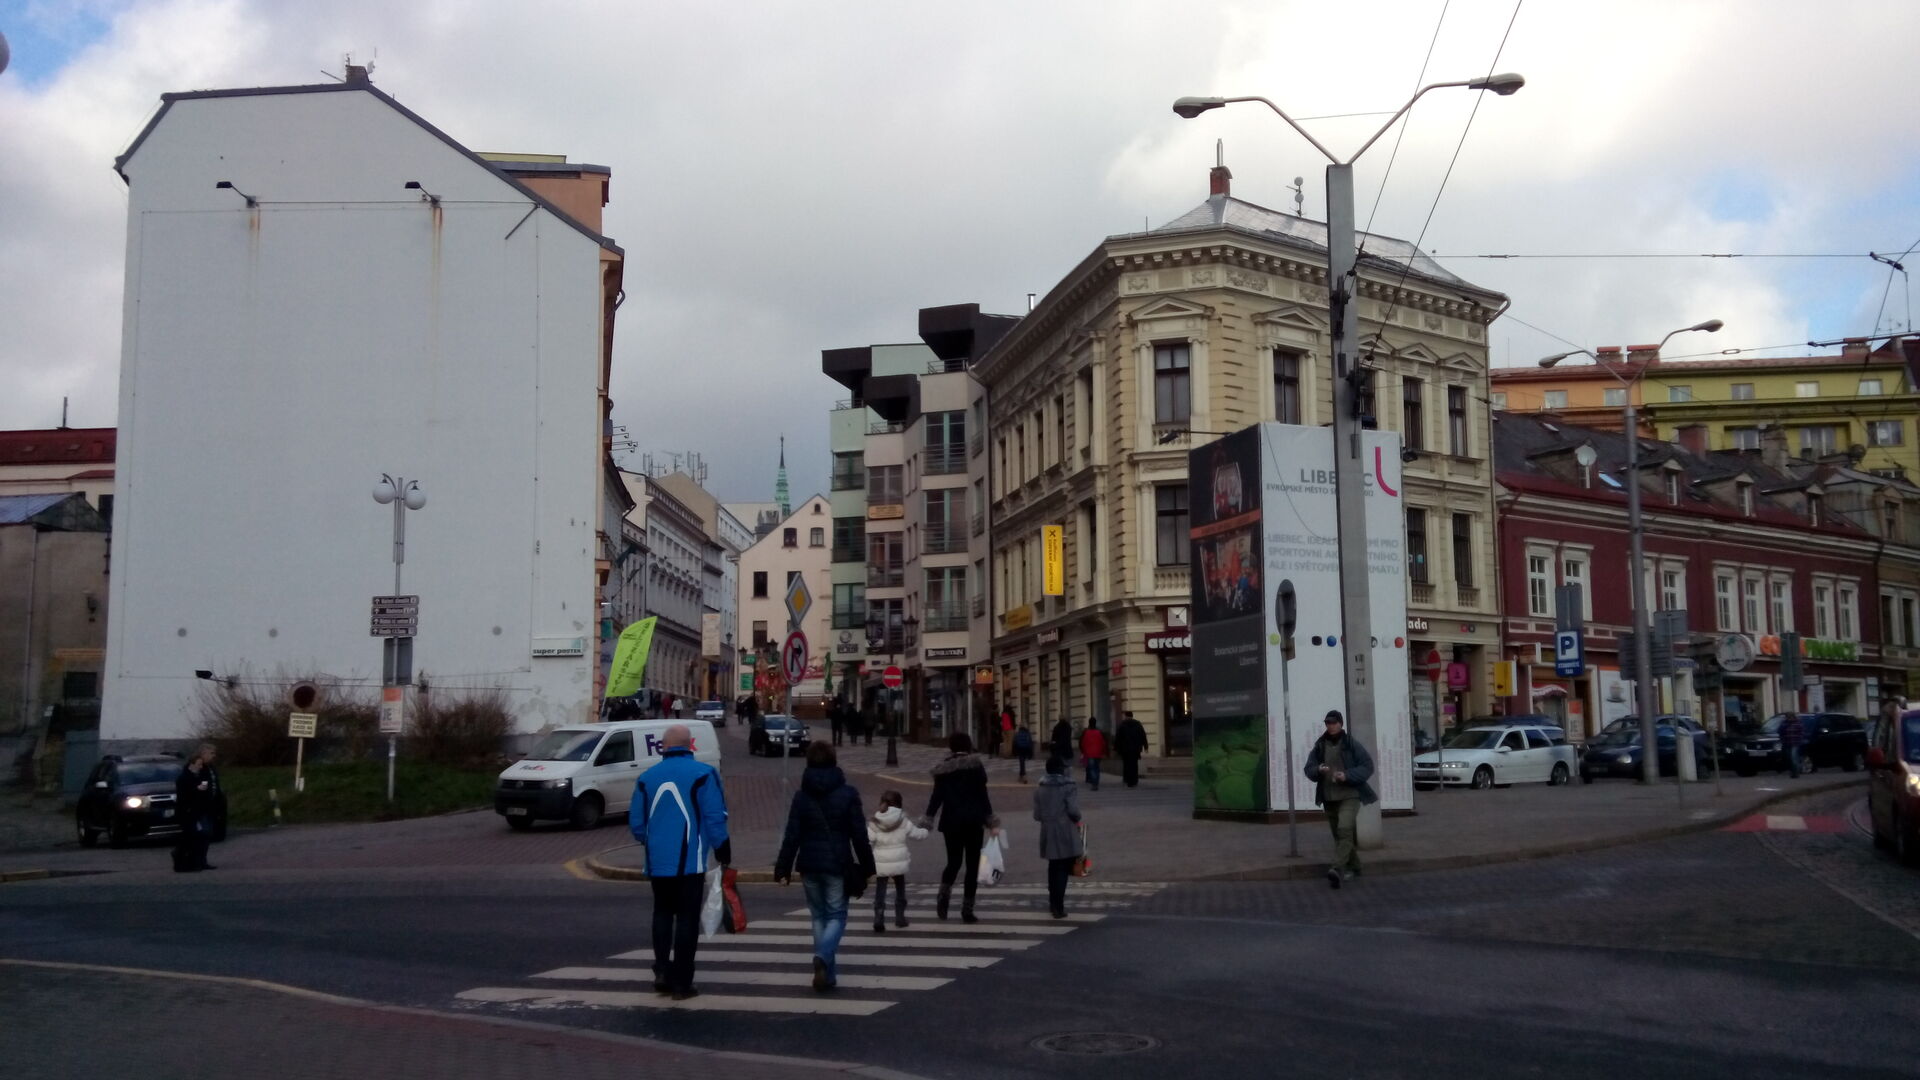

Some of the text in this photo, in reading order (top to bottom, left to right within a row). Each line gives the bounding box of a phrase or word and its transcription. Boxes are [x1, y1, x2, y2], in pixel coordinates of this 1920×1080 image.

[1147, 633, 1192, 649] arcad
[1560, 636, 1575, 656] P
[645, 734, 698, 756] Fex
